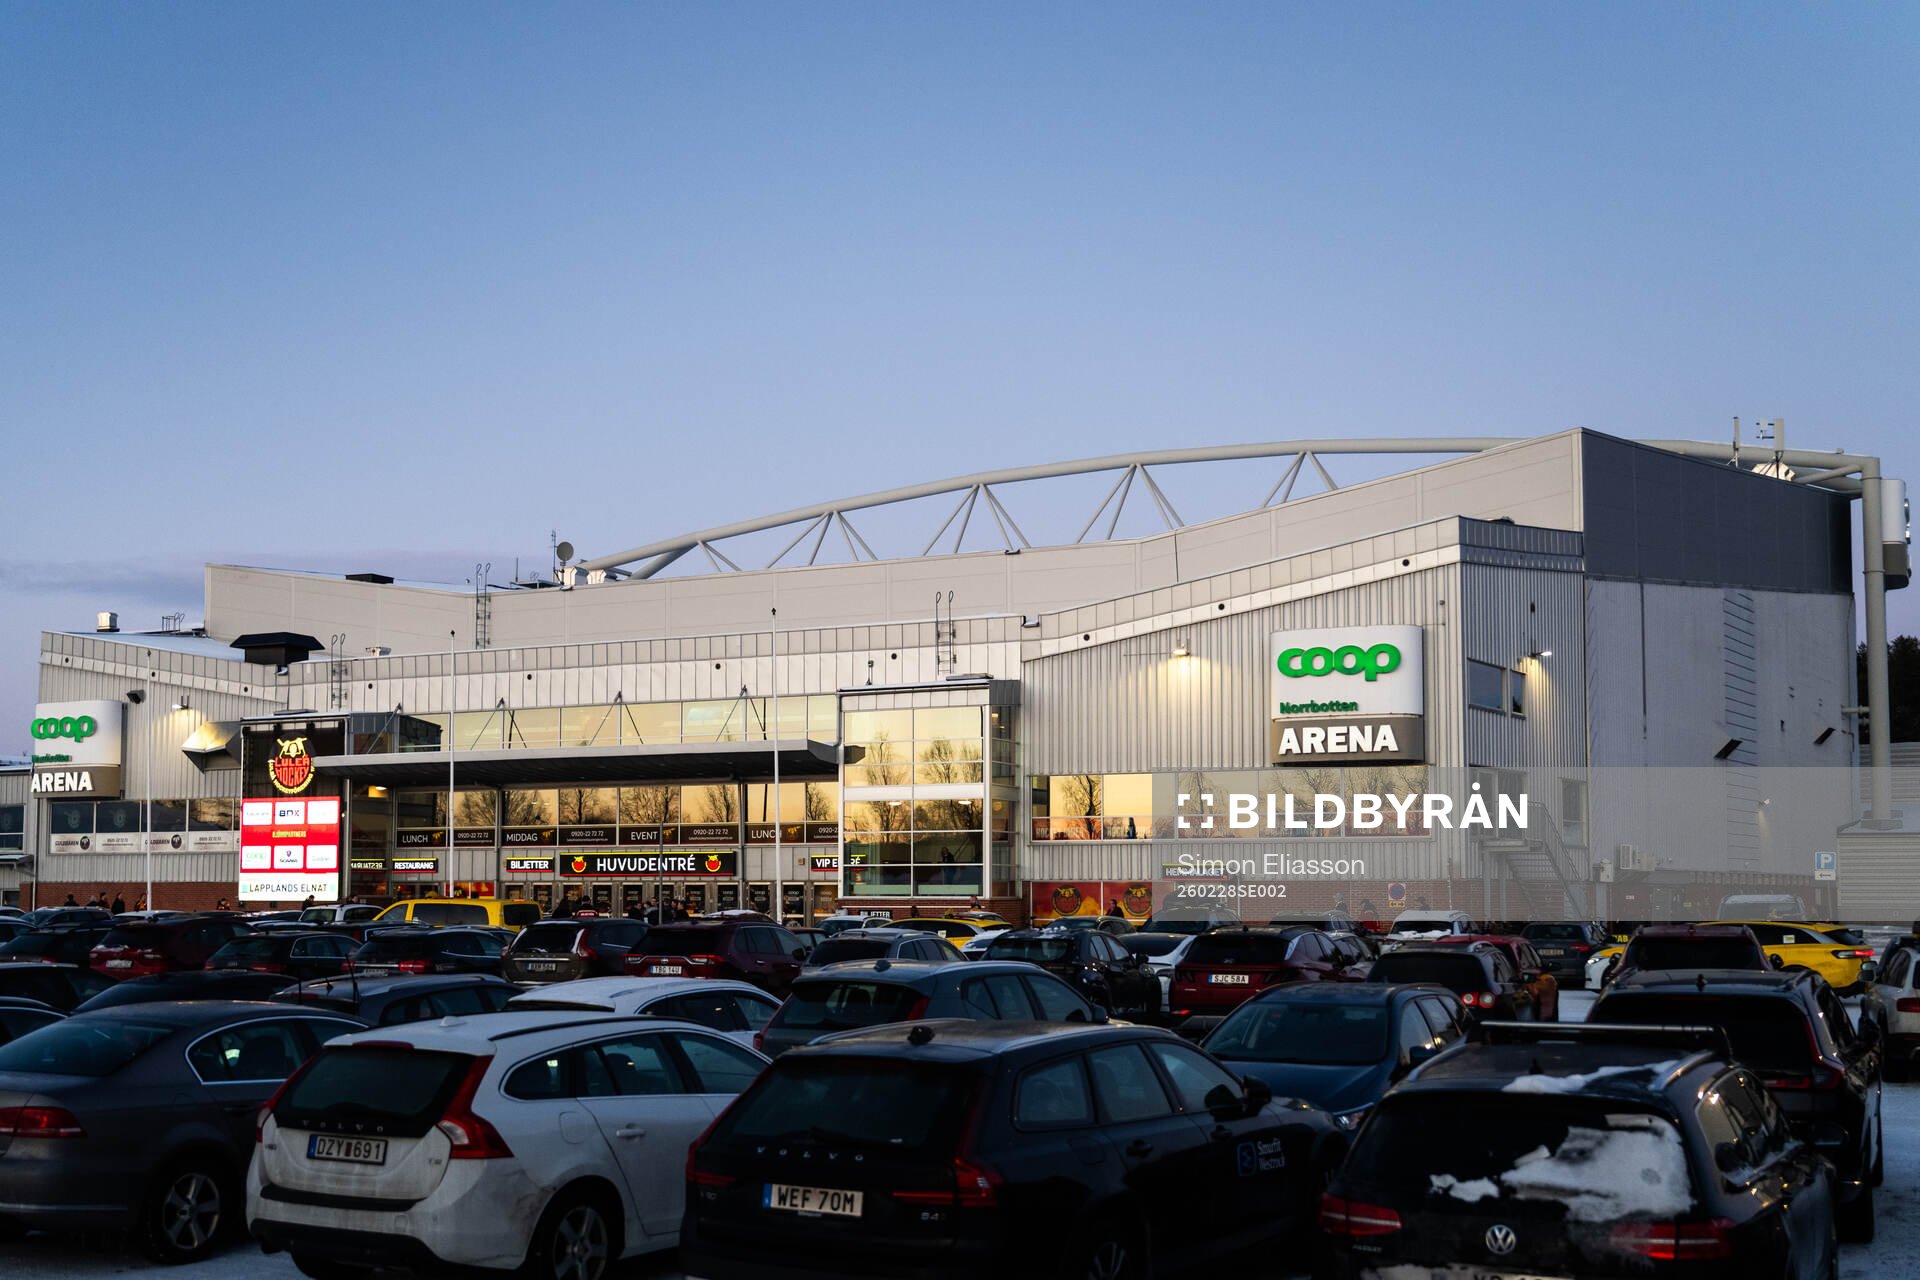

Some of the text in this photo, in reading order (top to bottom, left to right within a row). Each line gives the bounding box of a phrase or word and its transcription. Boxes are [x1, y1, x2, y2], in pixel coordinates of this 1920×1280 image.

[1277, 643, 1402, 682] coop
[1279, 699, 1359, 714] Norrbotten
[31, 715, 95, 743] coop
[1278, 724, 1399, 755] ARENA
[275, 754, 310, 767] LULEÅ
[31, 771, 93, 793] ARENA
[275, 767, 310, 787] HOCKEY
[402, 834, 429, 843] LUNCH
[506, 833, 538, 842] MIDDAG
[630, 831, 658, 841] EVENT
[394, 861, 434, 870] RESTAURANG
[510, 860, 549, 869] BILJETTER
[596, 854, 696, 872] HUVUDENTRÉ
[815, 858, 831, 868] VIP
[1821, 853, 1832, 869] P
[249, 883, 298, 893] LAPPLANDS
[1214, 975, 1246, 983] SJC 58A
[302, 1119, 384, 1133] VOLVO
[317, 1138, 381, 1160] DZY 691
[756, 1145, 864, 1162] VOLVO
[778, 1186, 855, 1213] WEF 70M
